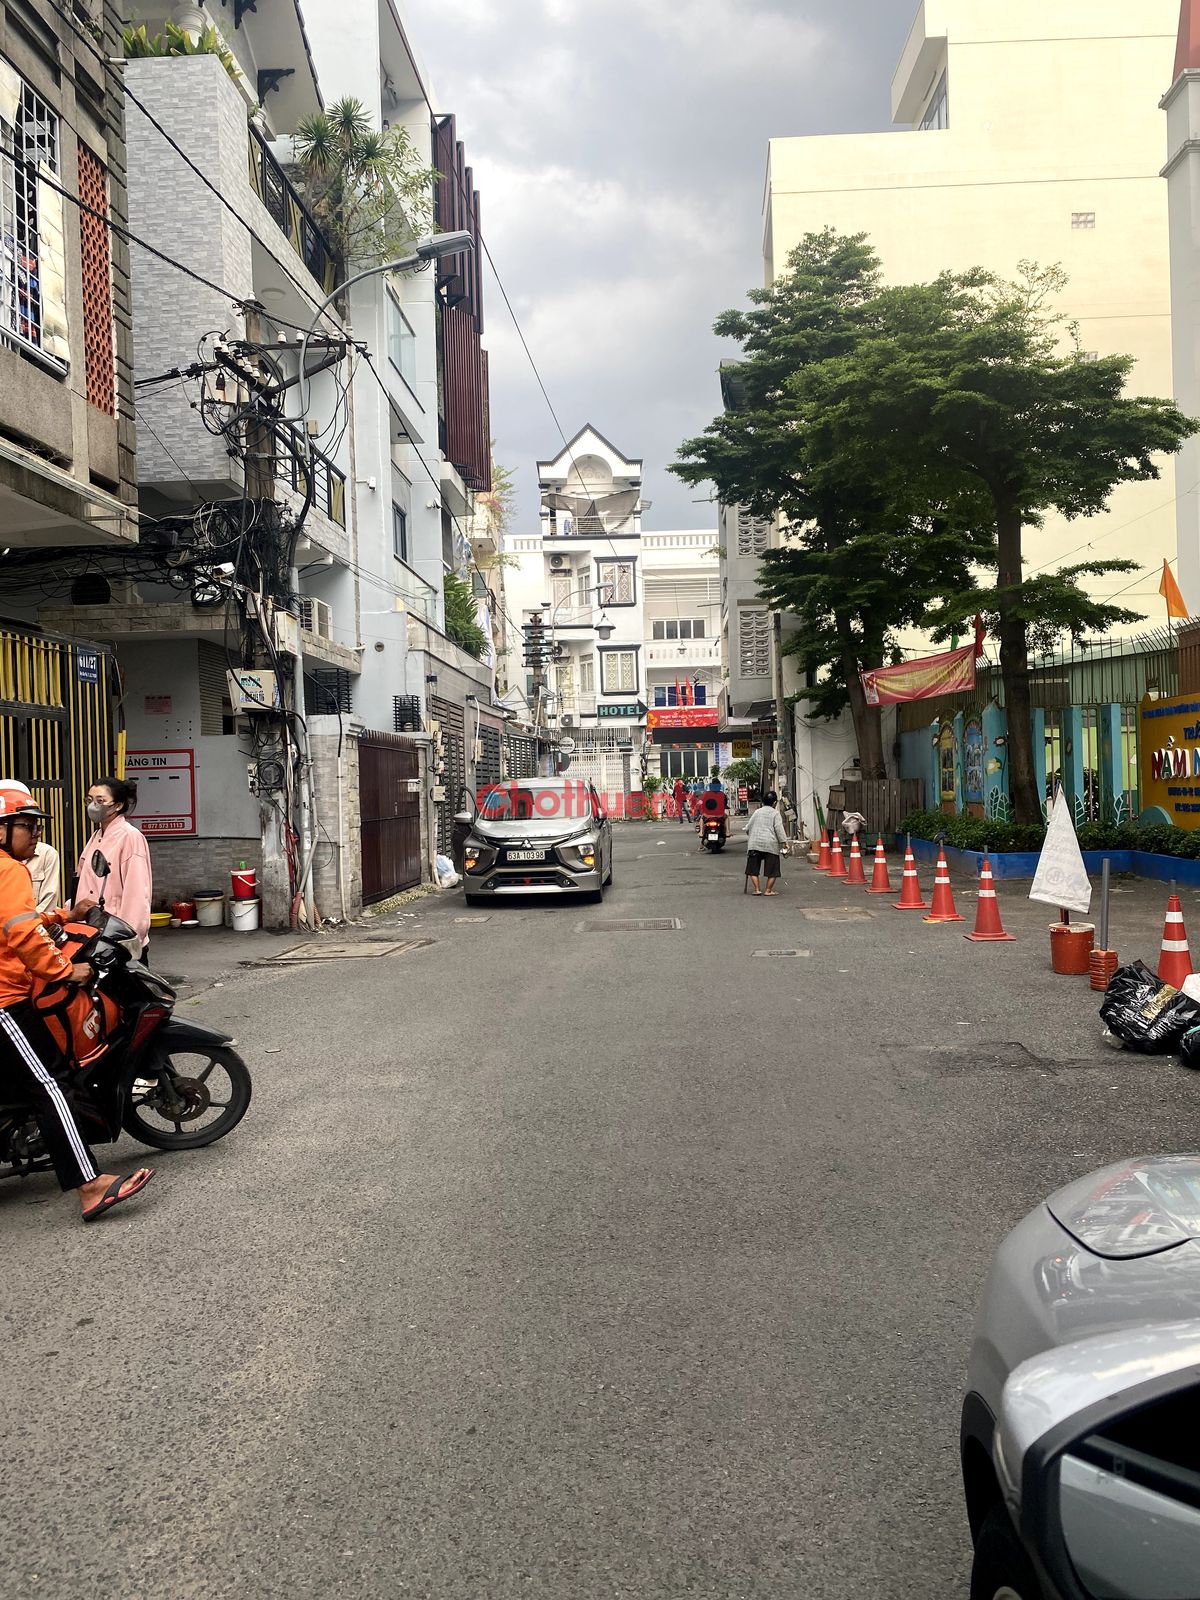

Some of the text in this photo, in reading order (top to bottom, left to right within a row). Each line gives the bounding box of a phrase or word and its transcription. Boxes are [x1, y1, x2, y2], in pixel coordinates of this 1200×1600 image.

[599, 705, 643, 716] HOTEL
[125, 756, 167, 766] ẢNG TIN
